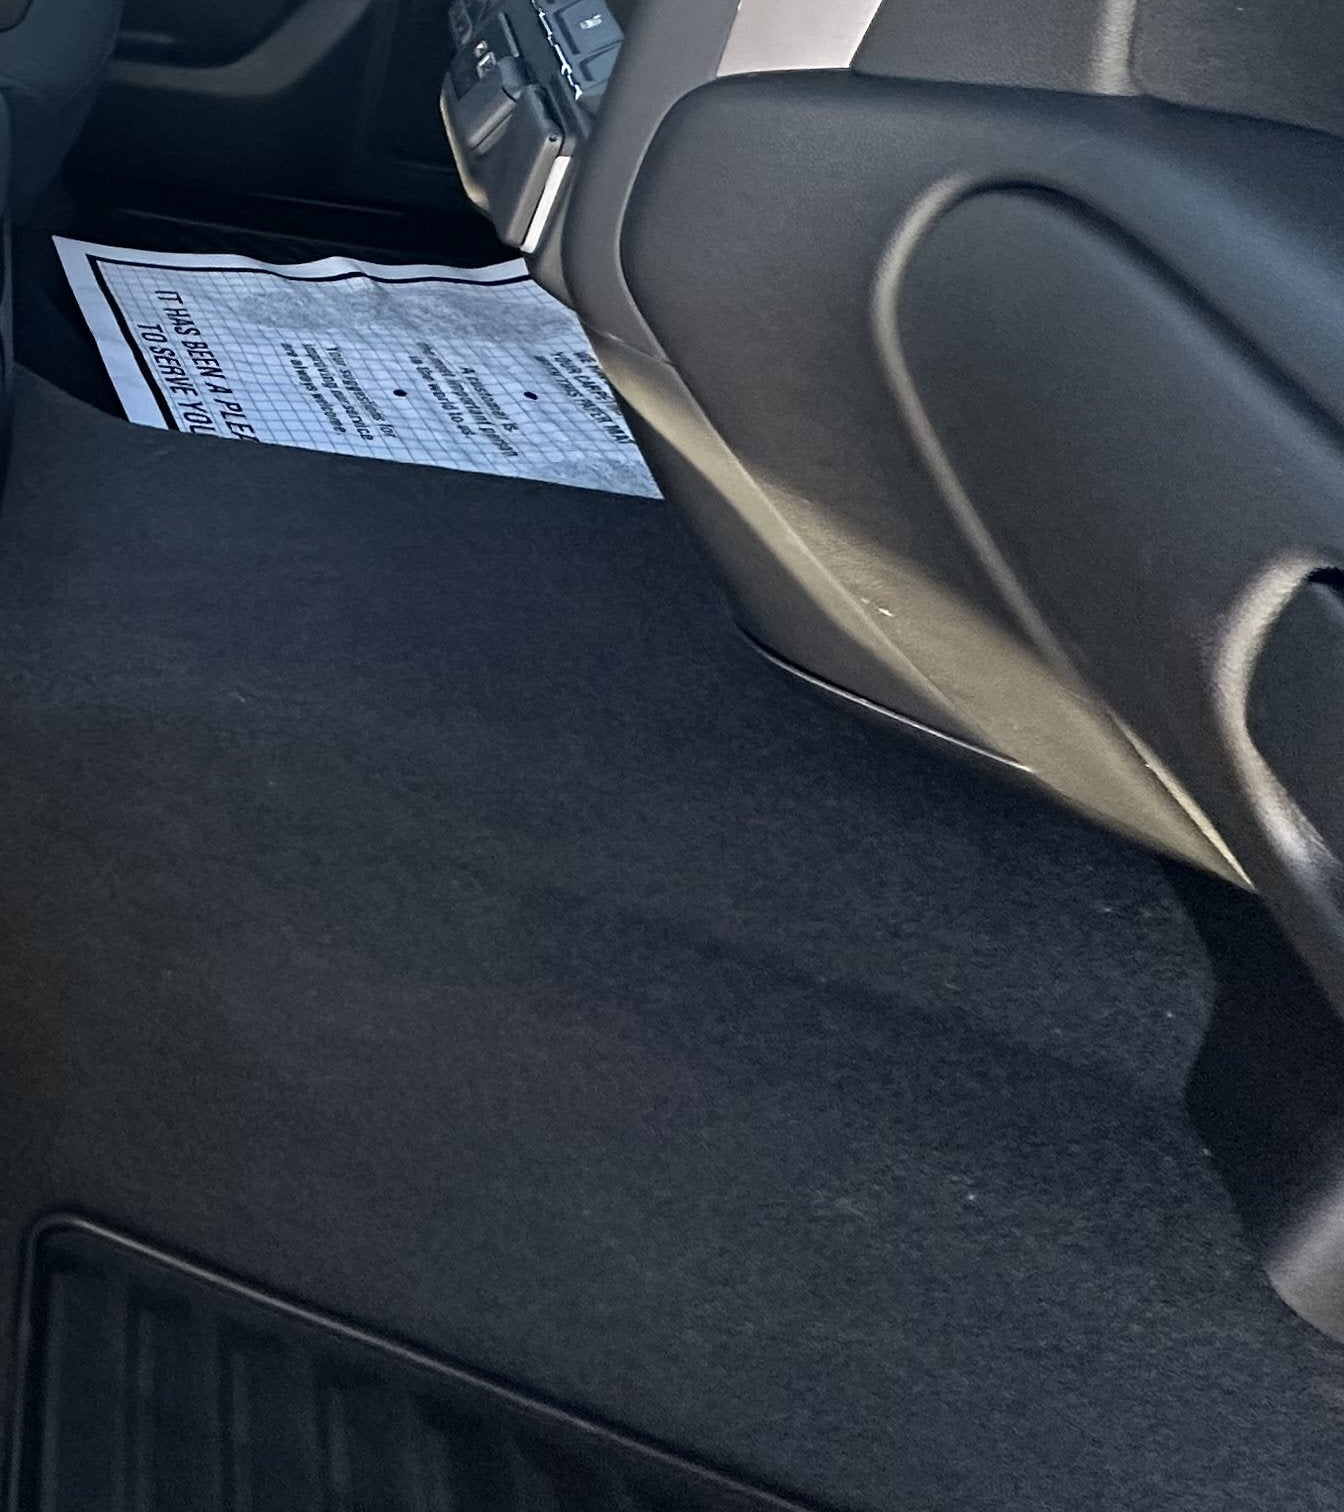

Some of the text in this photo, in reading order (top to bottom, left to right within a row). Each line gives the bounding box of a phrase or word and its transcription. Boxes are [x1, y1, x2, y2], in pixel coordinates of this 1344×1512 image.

[154, 290, 184, 305] IT
[136, 323, 168, 343] TO
[163, 308, 201, 336] HAS
[149, 346, 199, 397] SERVE
[181, 340, 226, 379] BEEN
[281, 343, 298, 357] are
[290, 359, 318, 392] always
[550, 352, 582, 374] YOUR
[204, 381, 233, 394] A
[302, 344, 374, 440] improving our service
[326, 347, 396, 438] Your suggestions for
[416, 366, 435, 381] the
[428, 384, 459, 410] world
[448, 412, 464, 423] to
[428, 356, 456, 377] most
[445, 378, 493, 424] important
[478, 427, 518, 457] person
[466, 376, 510, 420] customer
[555, 377, 584, 397] THIS
[573, 399, 613, 423] PAPER
[603, 425, 635, 444] MAT
